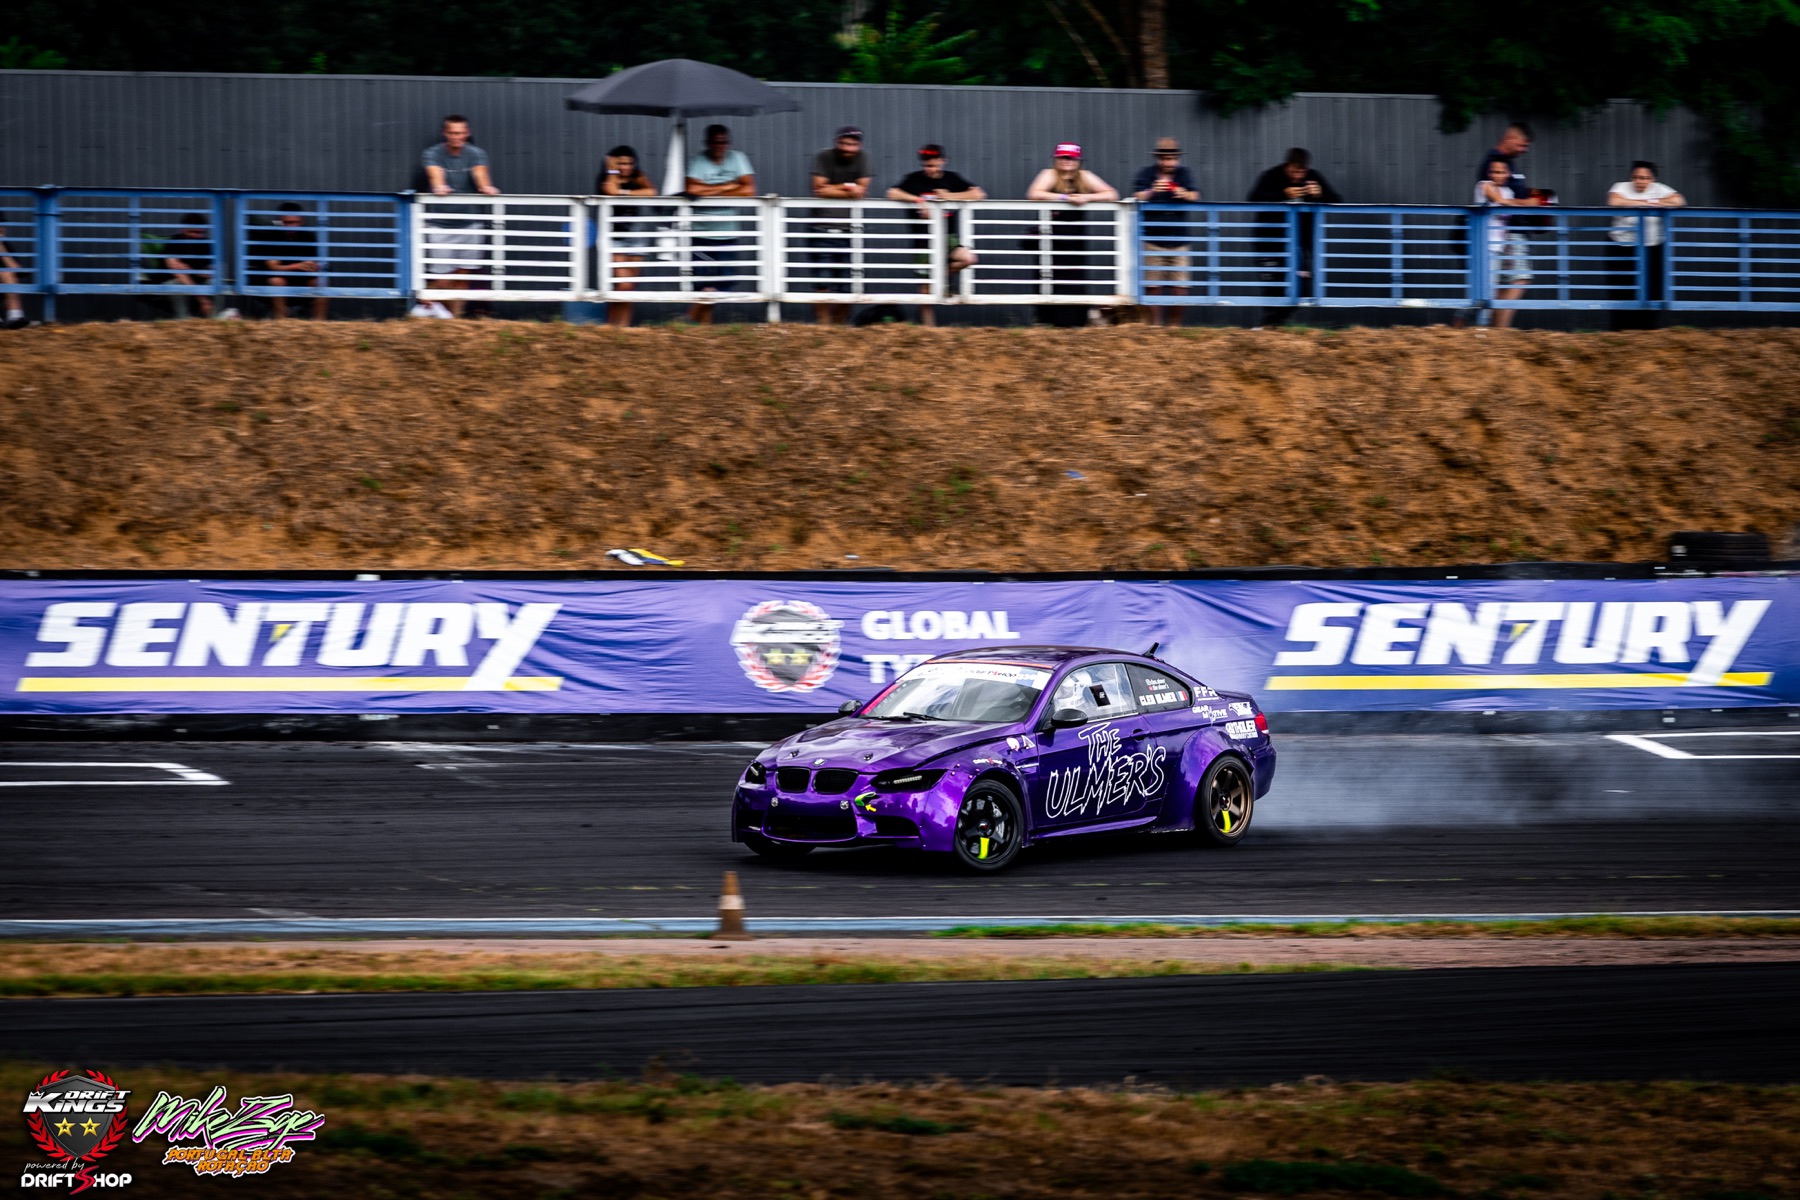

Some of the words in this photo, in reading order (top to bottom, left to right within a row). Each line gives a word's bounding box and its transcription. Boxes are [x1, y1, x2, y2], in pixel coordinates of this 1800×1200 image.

[24, 602, 562, 690] SENTURY
[861, 610, 1020, 640] GLOBAL
[1273, 600, 1772, 686] SENTURY
[862, 654, 936, 684] TY
[1078, 722, 1122, 765] THE
[1046, 744, 1166, 818] ULMER'S
